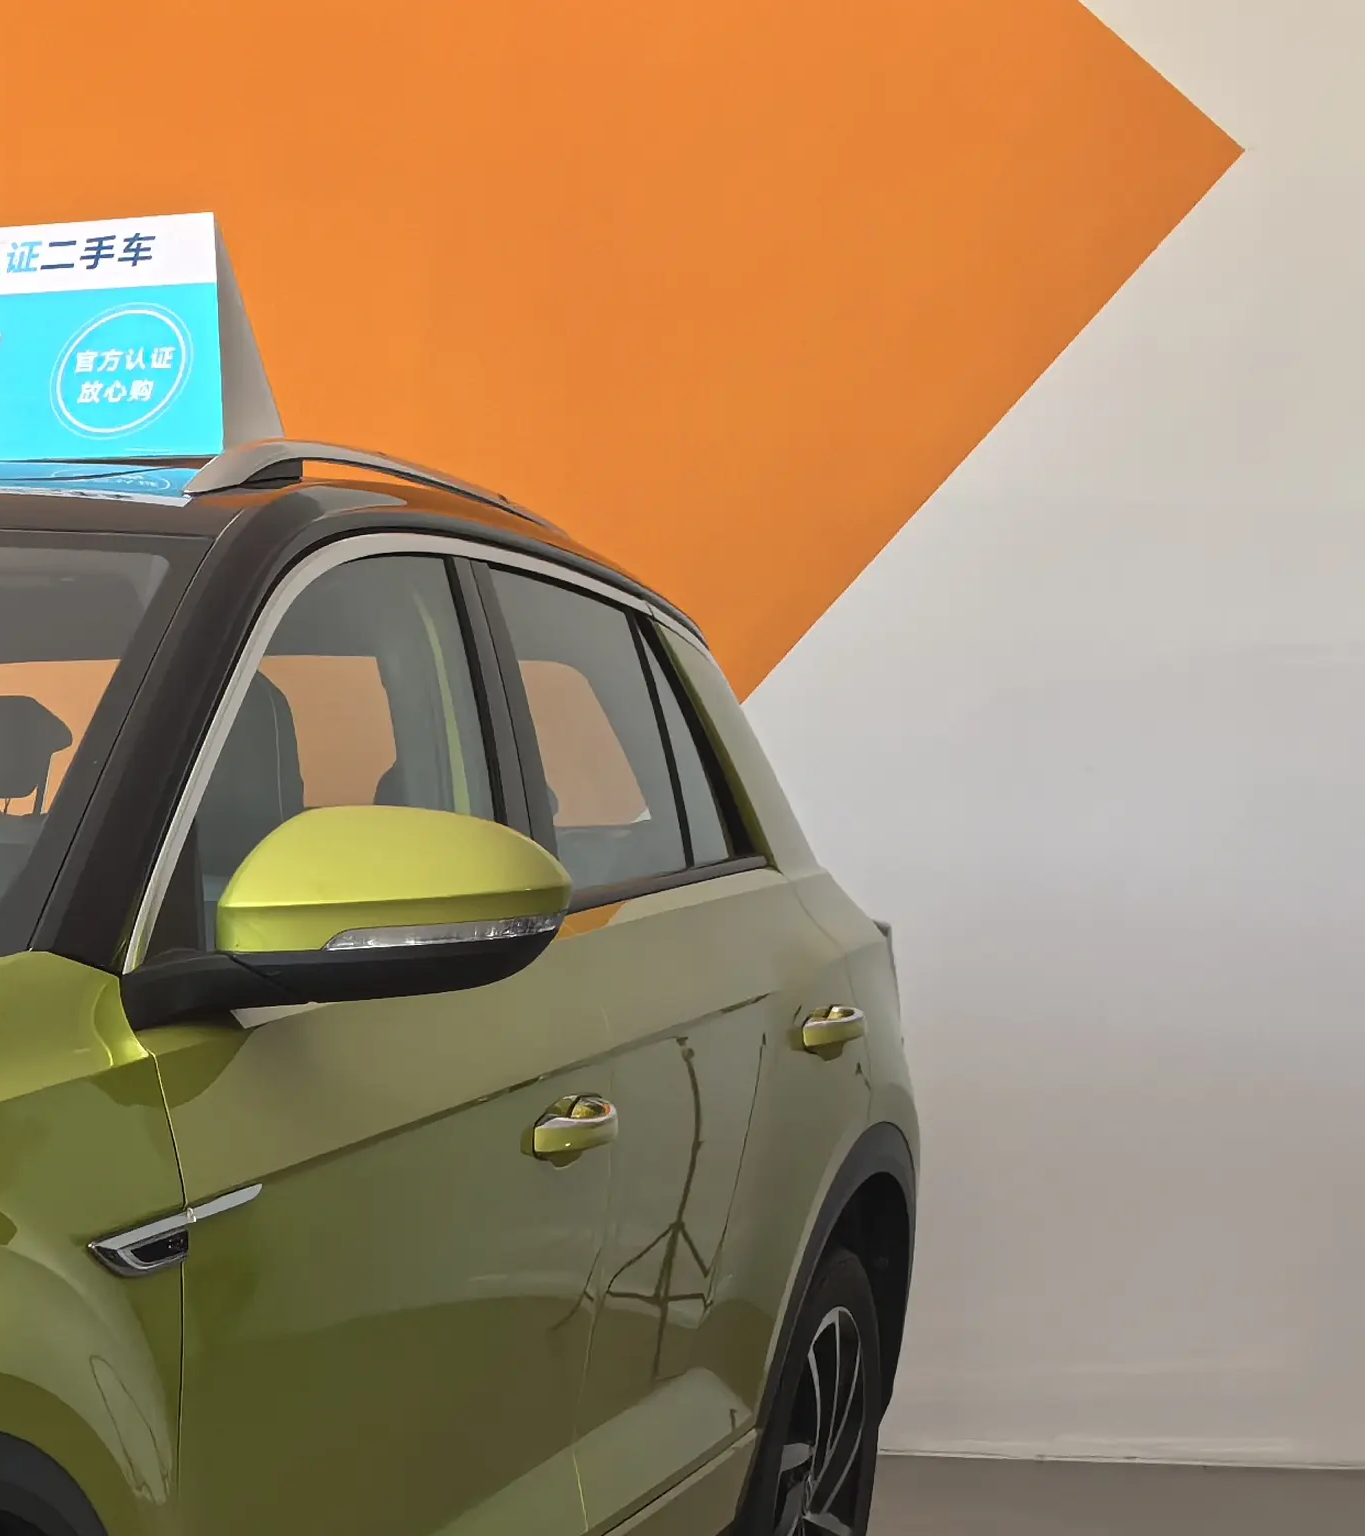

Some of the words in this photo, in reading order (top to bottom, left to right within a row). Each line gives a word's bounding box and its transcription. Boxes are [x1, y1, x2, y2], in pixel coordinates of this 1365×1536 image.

[74, 346, 176, 374] 官方认证
[76, 378, 155, 404] 放心购
